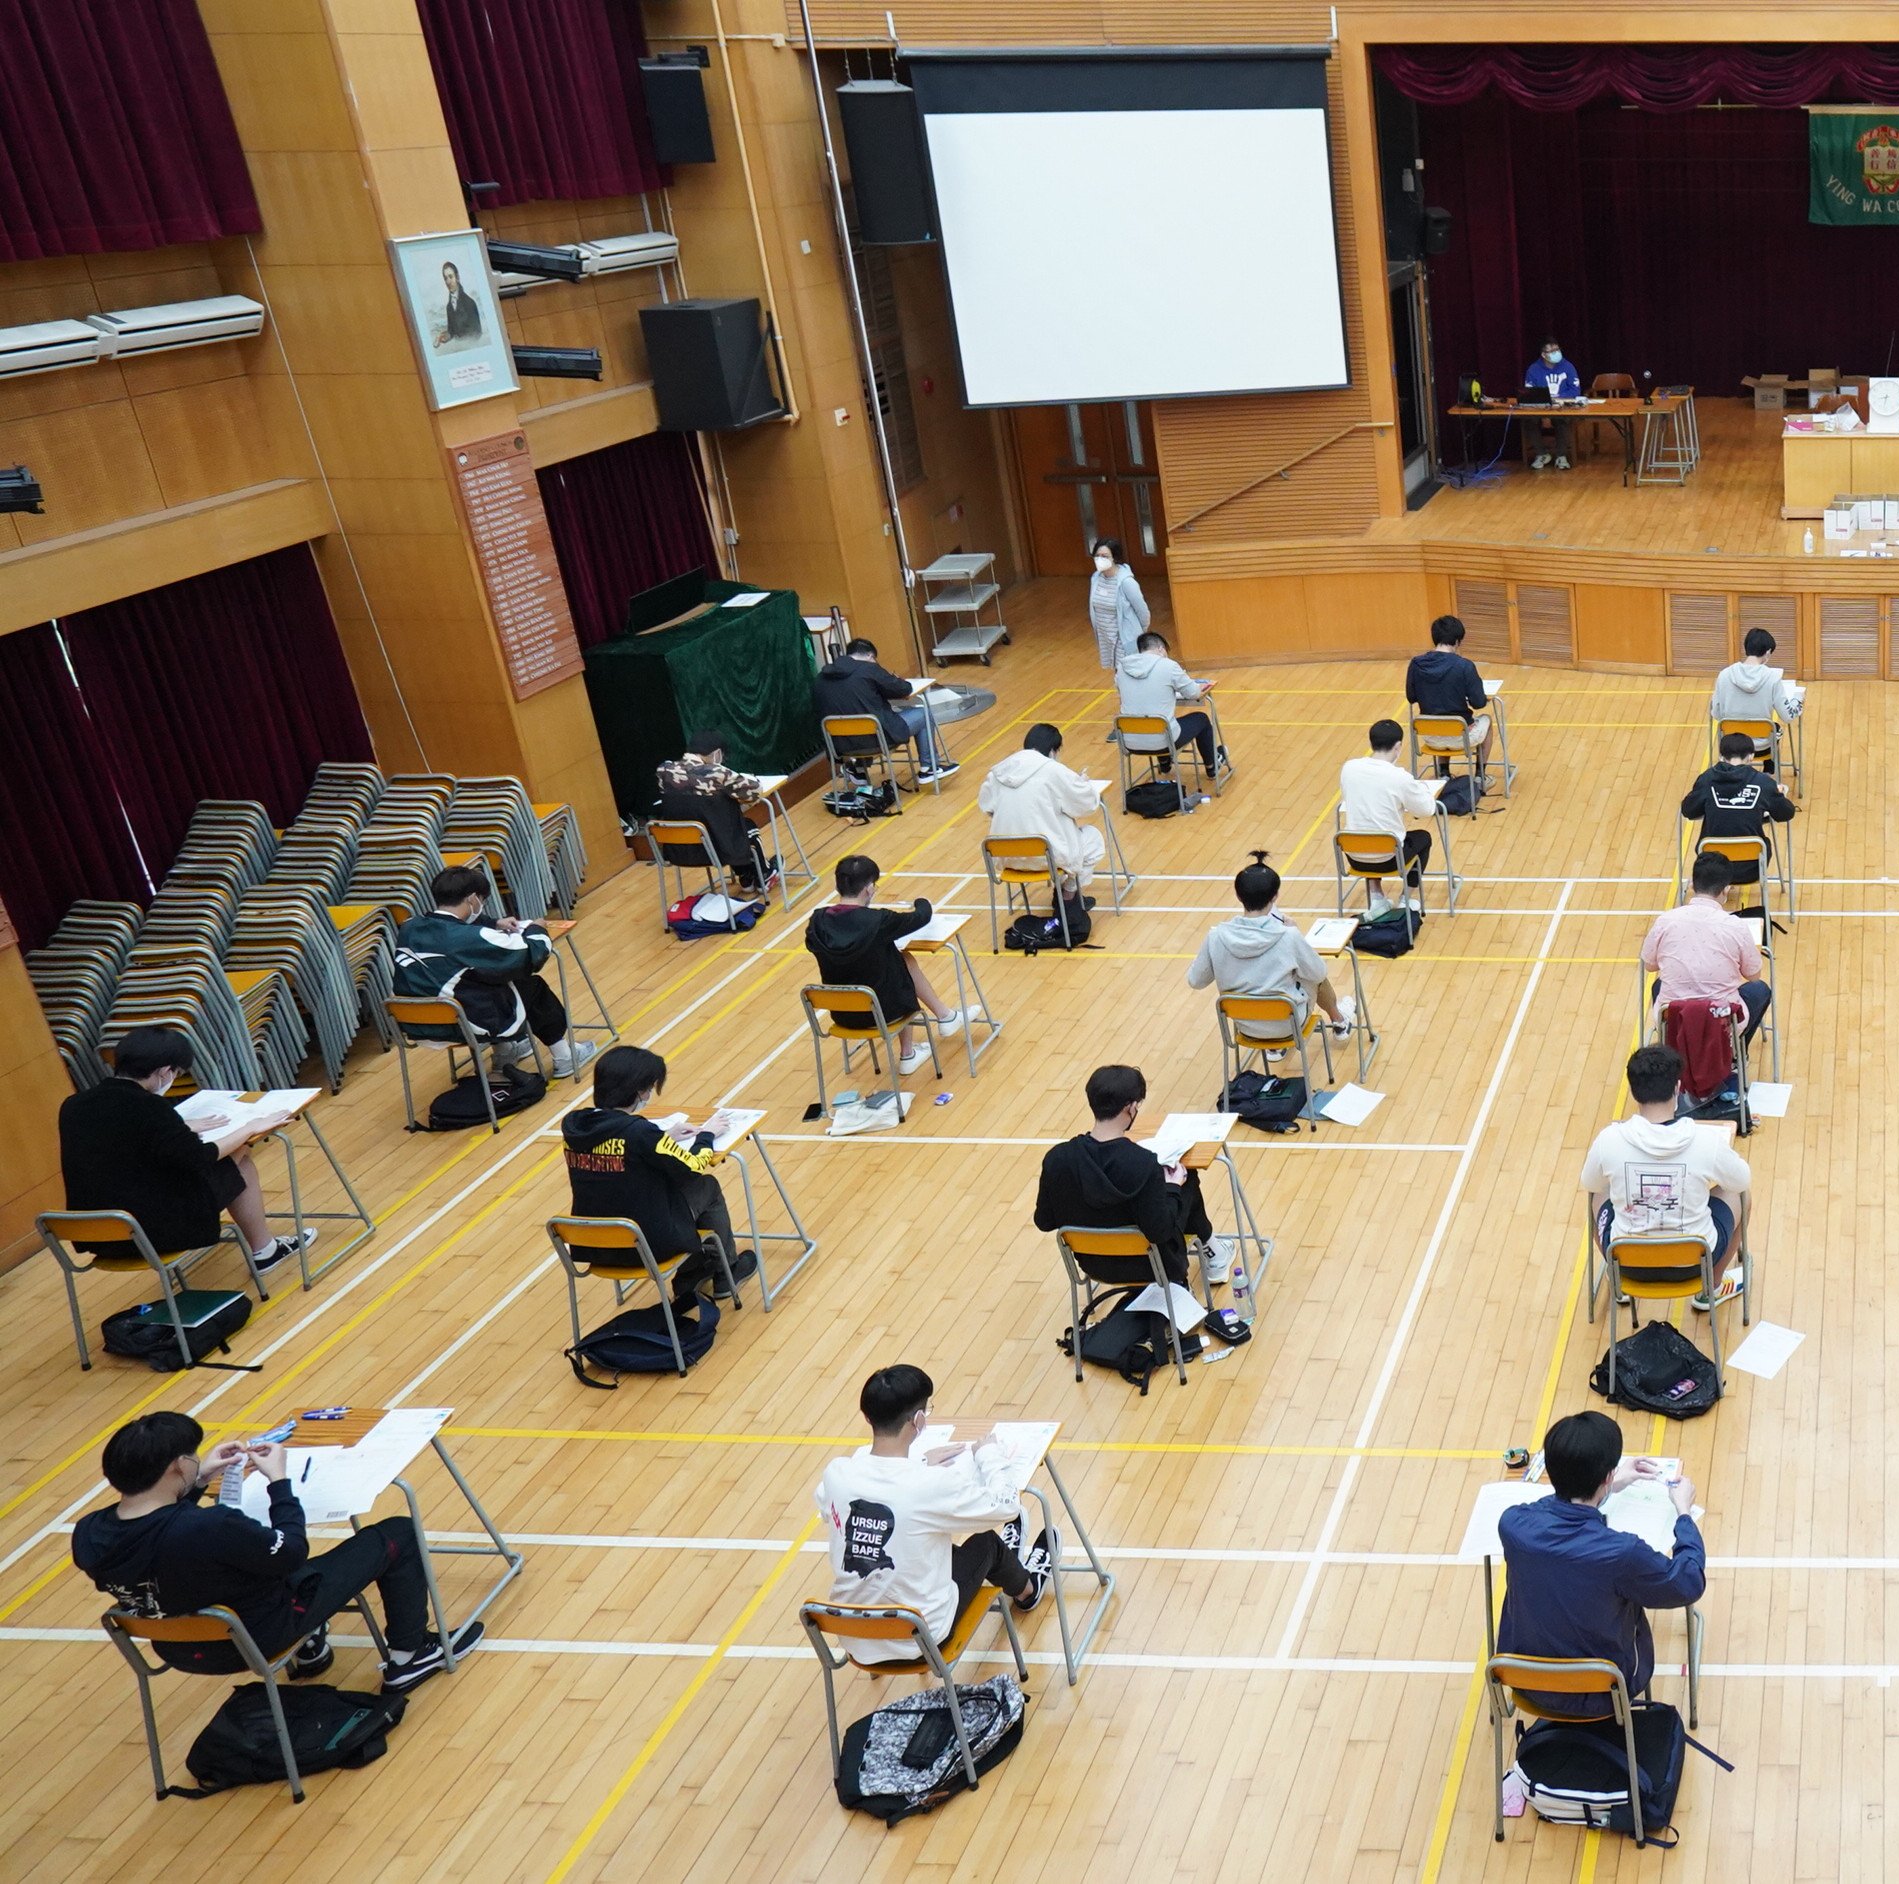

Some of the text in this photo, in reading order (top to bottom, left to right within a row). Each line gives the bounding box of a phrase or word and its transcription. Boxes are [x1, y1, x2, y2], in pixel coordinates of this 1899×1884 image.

[1826, 174, 1856, 205] YING
[1862, 198, 1882, 213] WA
[851, 1515, 888, 1532] URSUS
[851, 1544, 880, 1559] BAPE
